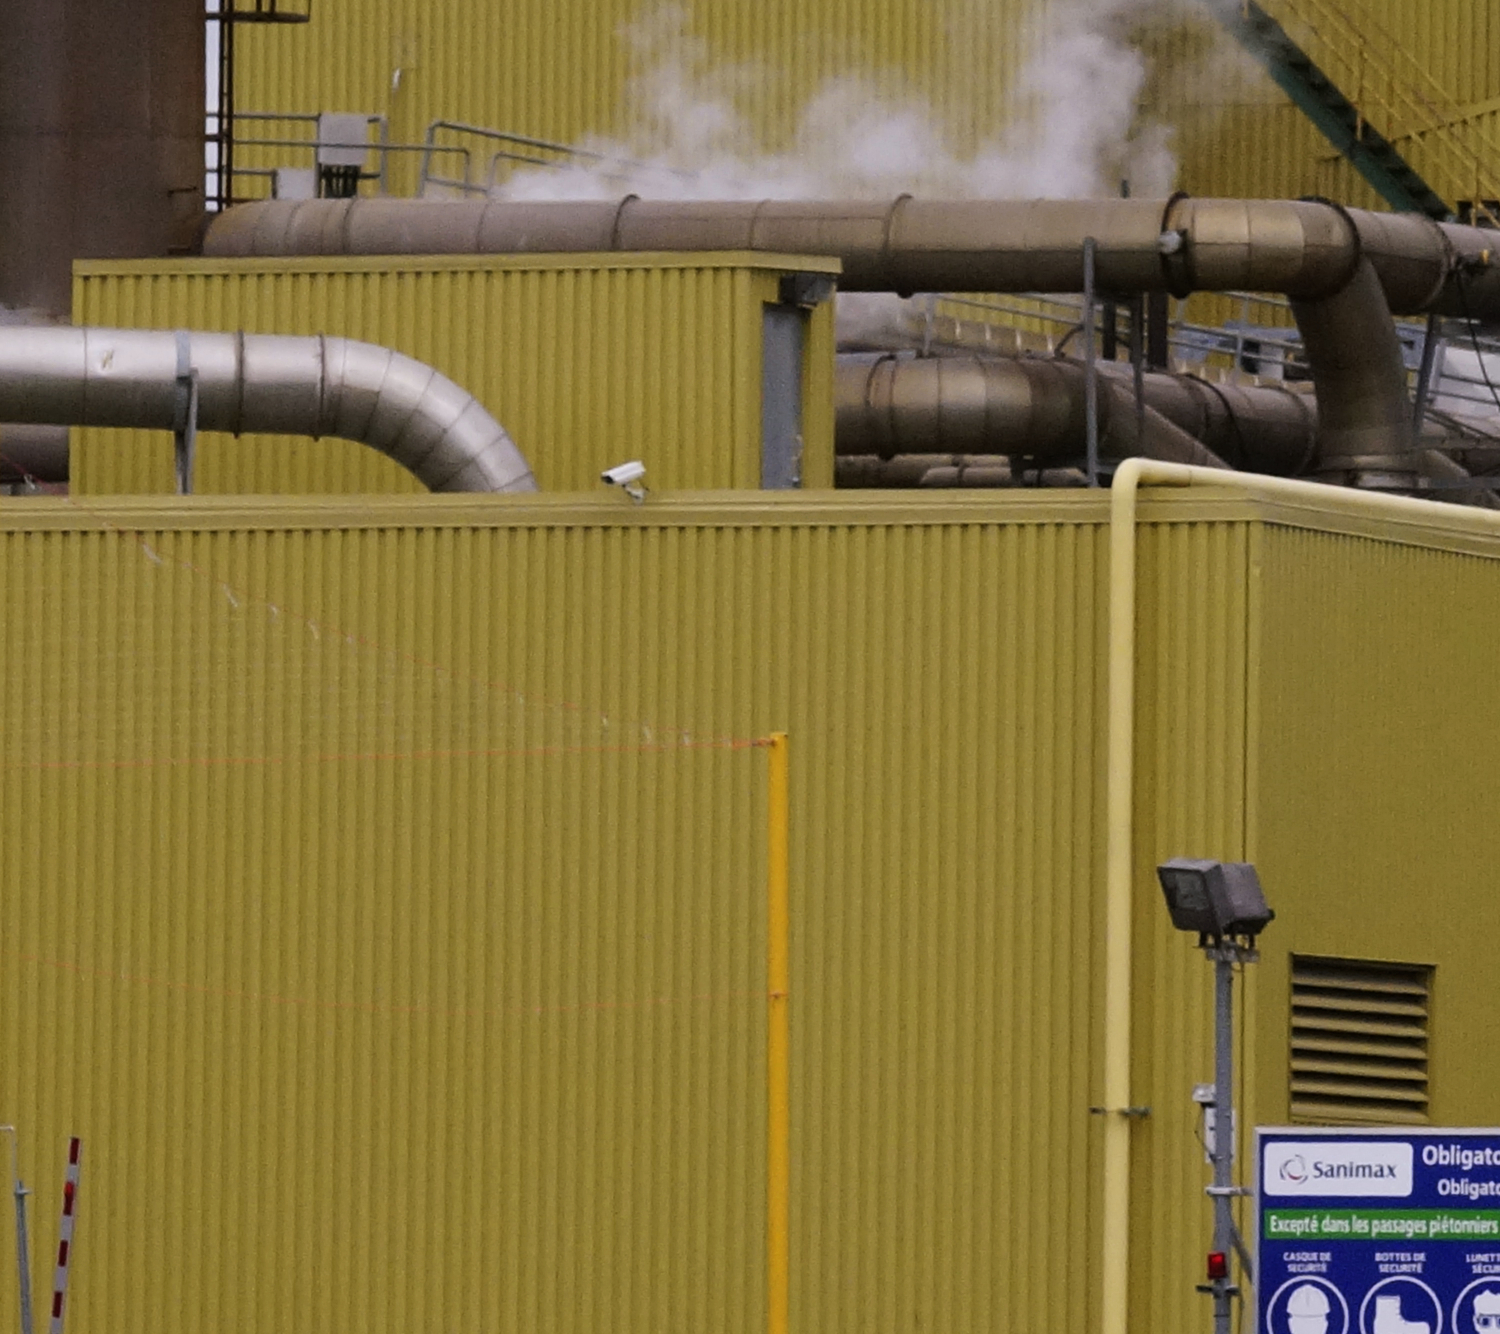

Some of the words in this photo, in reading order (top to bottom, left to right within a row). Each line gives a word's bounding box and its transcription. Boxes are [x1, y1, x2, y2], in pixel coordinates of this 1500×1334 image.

[1313, 1161, 1397, 1179] Sanimax
[1270, 1215, 1319, 1237] Excepté
[1322, 1215, 1350, 1233] dans
[1352, 1215, 1369, 1233] les
[1372, 1219, 1427, 1238] passages
[1429, 1216, 1498, 1237] piétonniers
[1283, 1252, 1318, 1262] CASQUE
[1375, 1252, 1411, 1262] BOTTES
